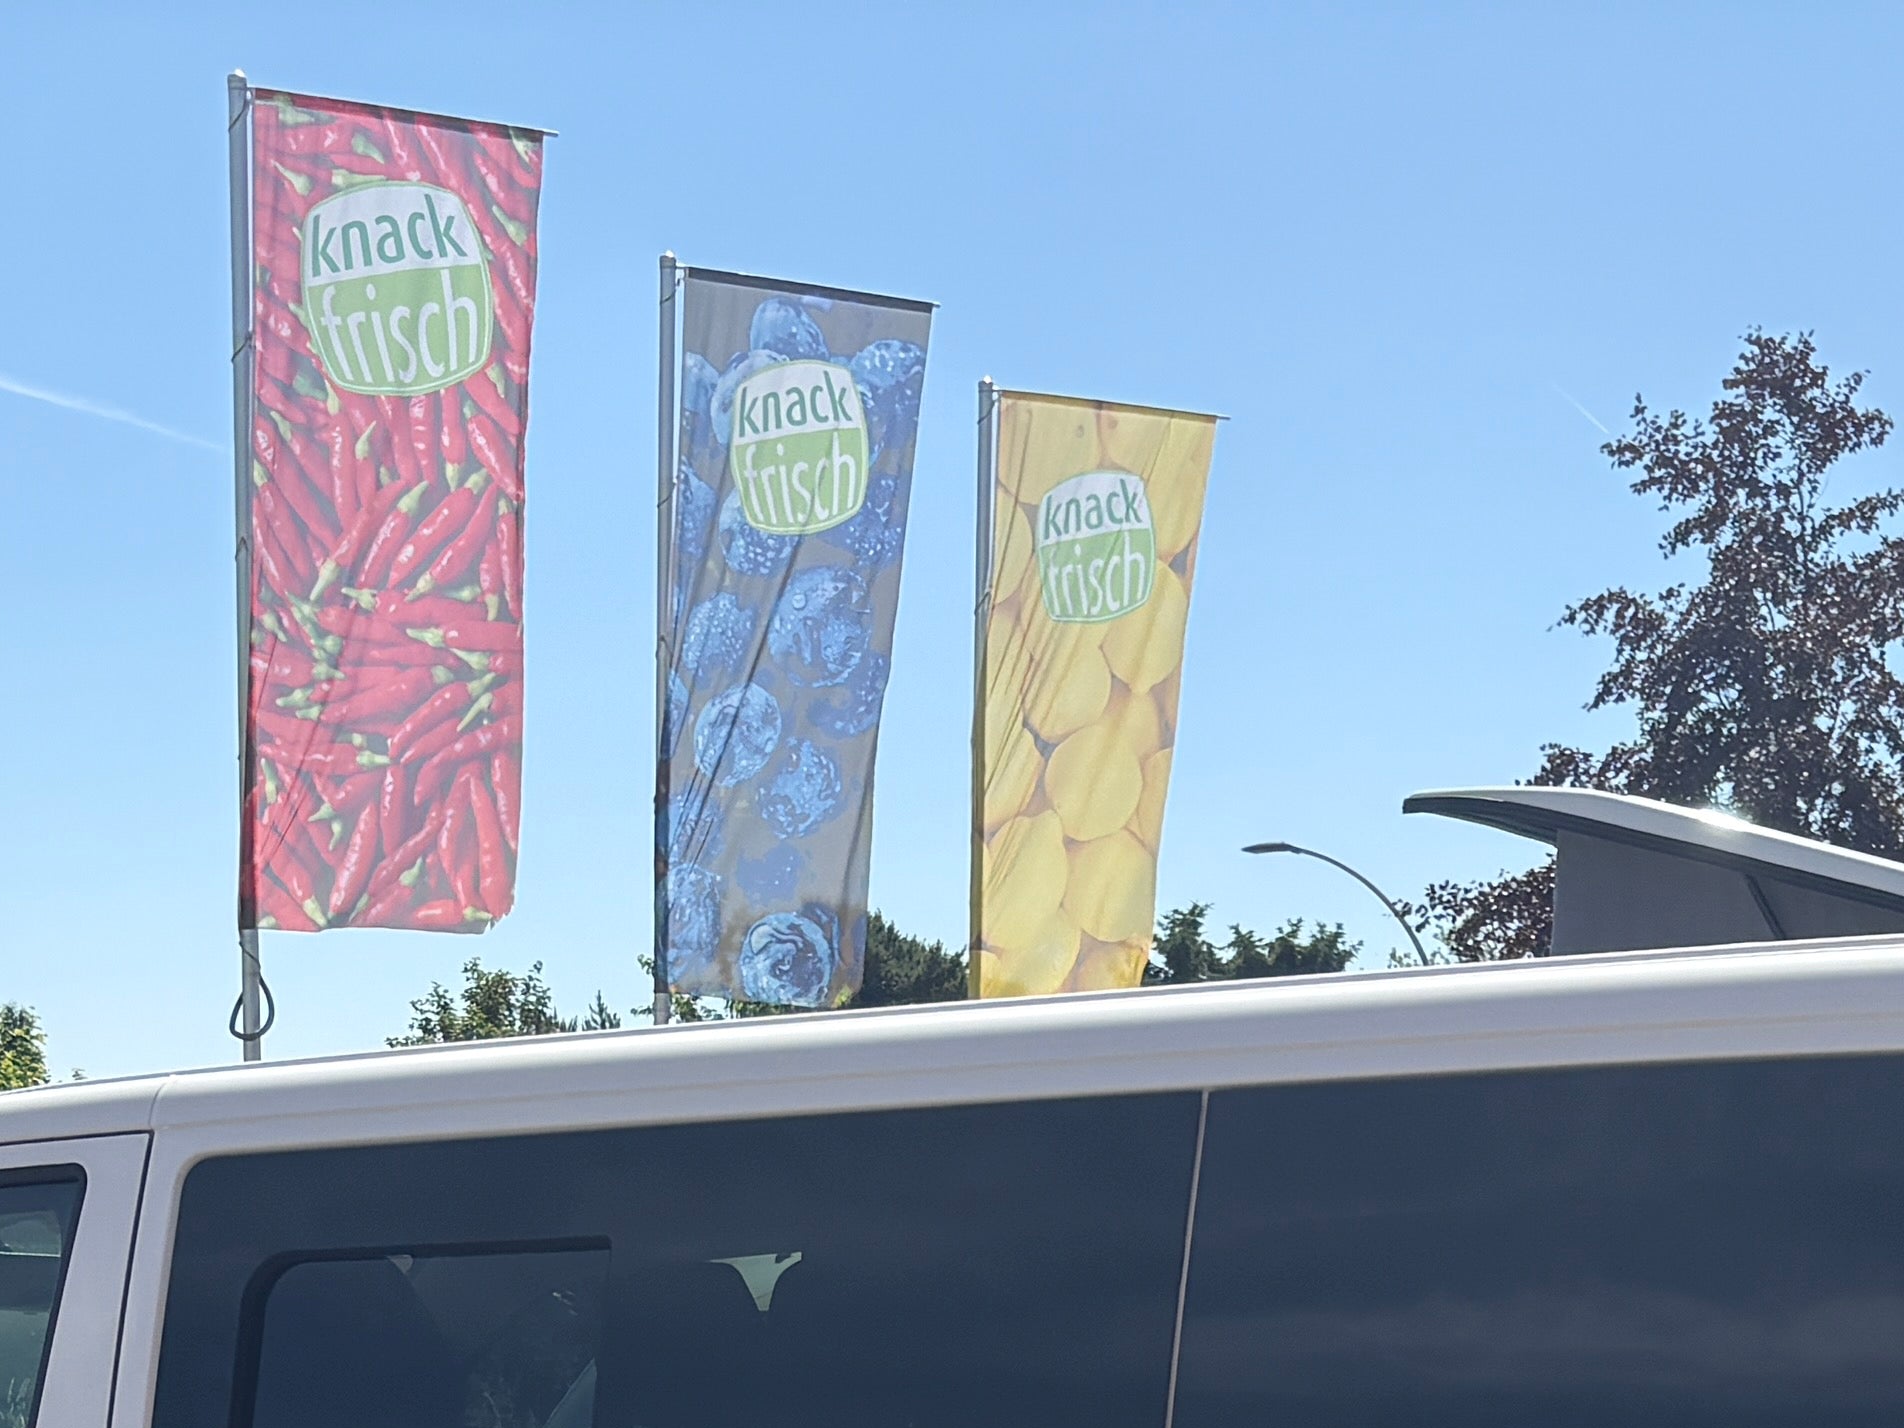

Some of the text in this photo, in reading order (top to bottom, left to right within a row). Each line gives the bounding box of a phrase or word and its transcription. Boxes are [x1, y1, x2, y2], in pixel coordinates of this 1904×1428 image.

[312, 194, 468, 277] knack
[321, 269, 478, 384] frisch
[739, 371, 852, 438] knack
[744, 432, 856, 525] frisch
[1044, 478, 1143, 540] knack
[1048, 531, 1145, 616] frisch
